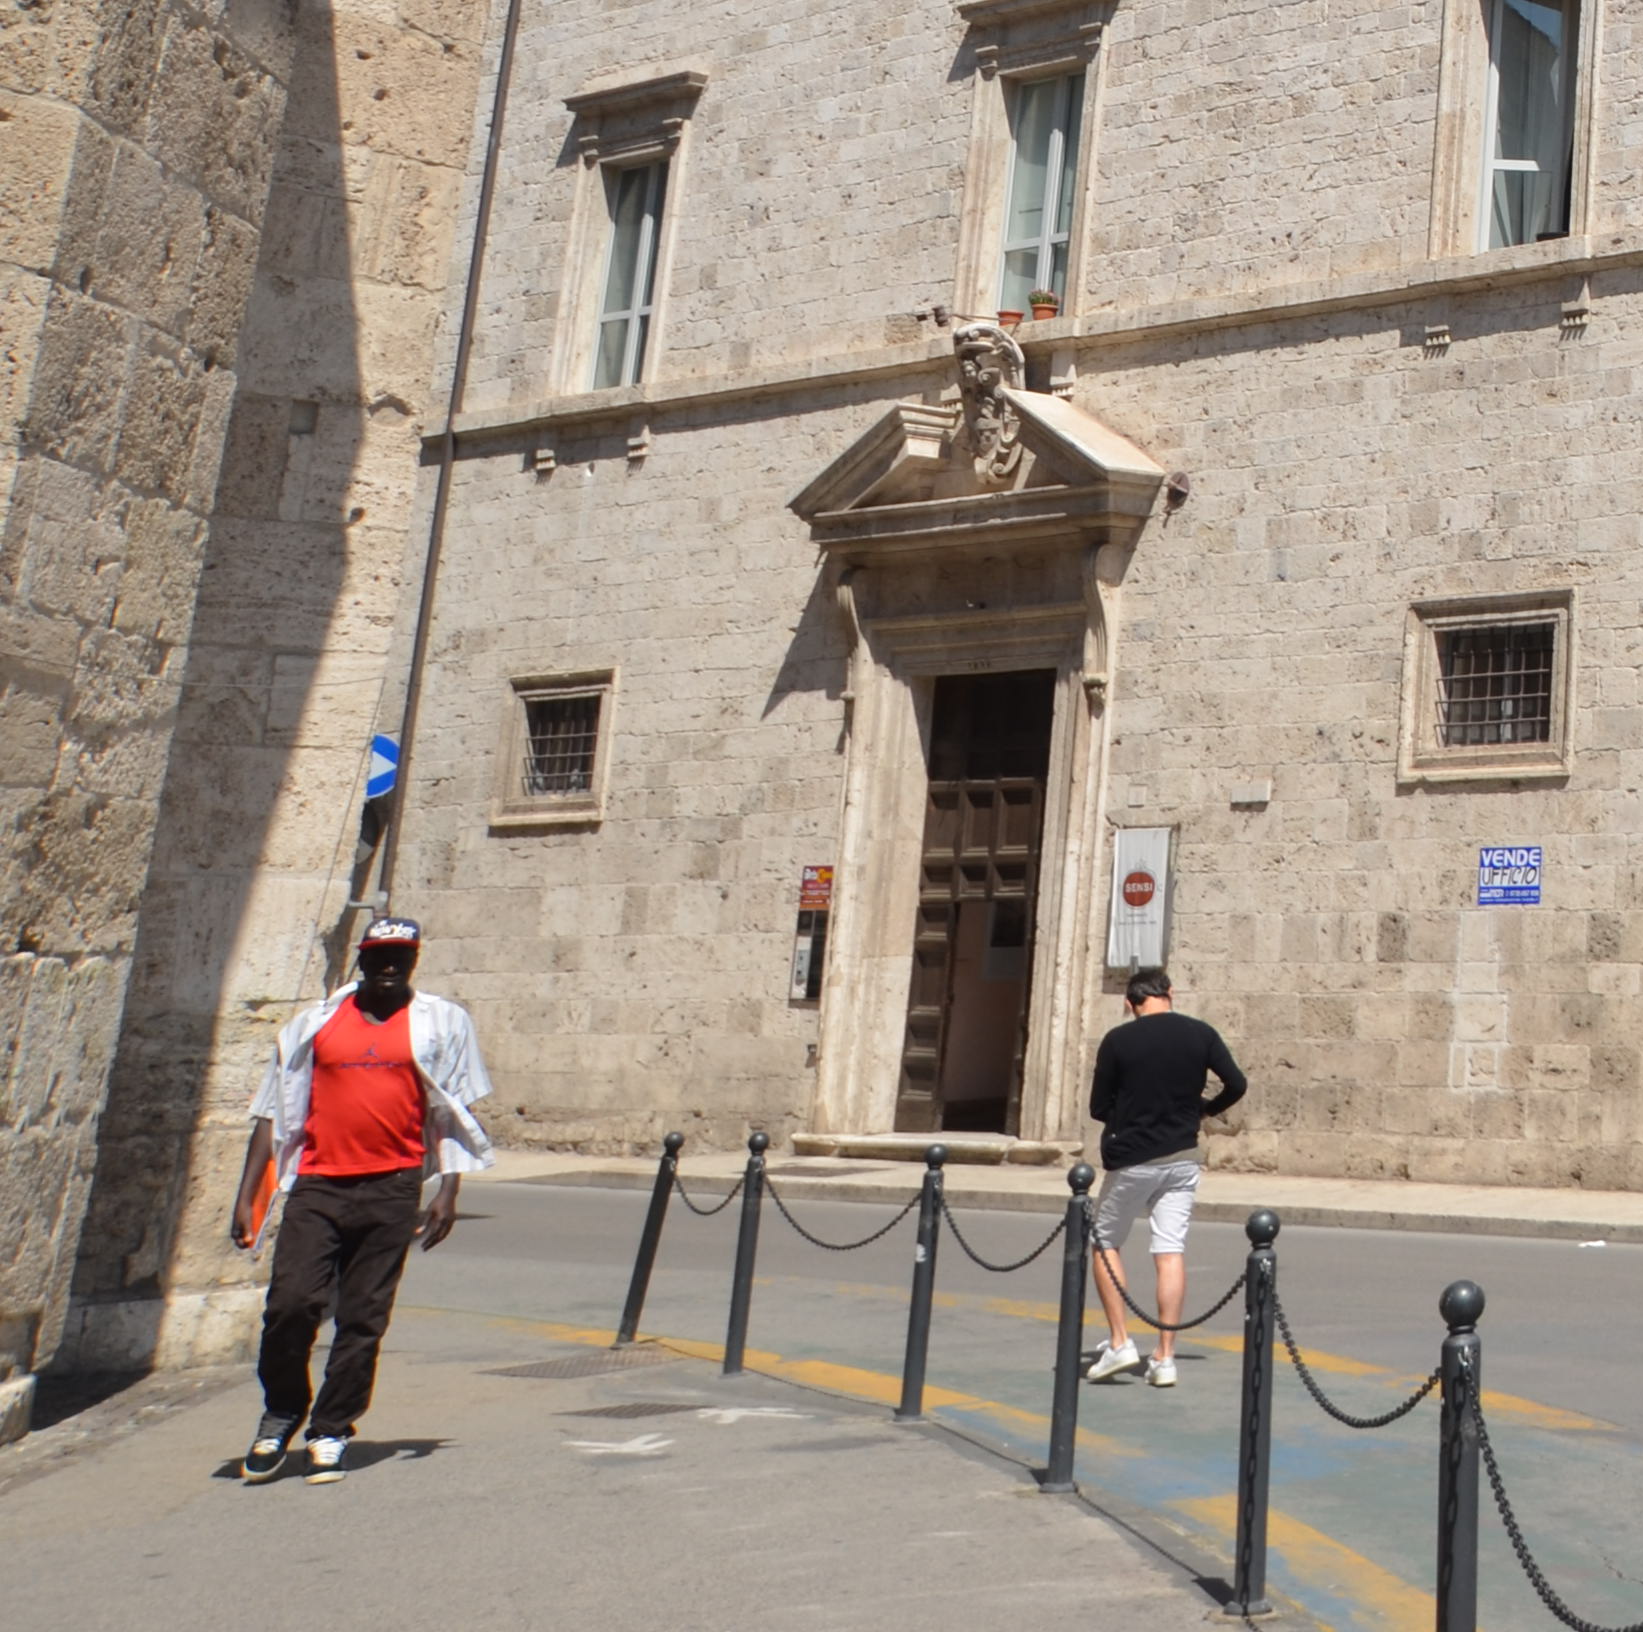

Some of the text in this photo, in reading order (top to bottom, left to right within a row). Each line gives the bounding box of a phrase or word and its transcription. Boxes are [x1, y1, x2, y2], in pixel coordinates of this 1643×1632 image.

[1481, 848, 1541, 867] VENDE
[1482, 867, 1537, 885] UFFICIO
[1125, 883, 1153, 894] SENSI
